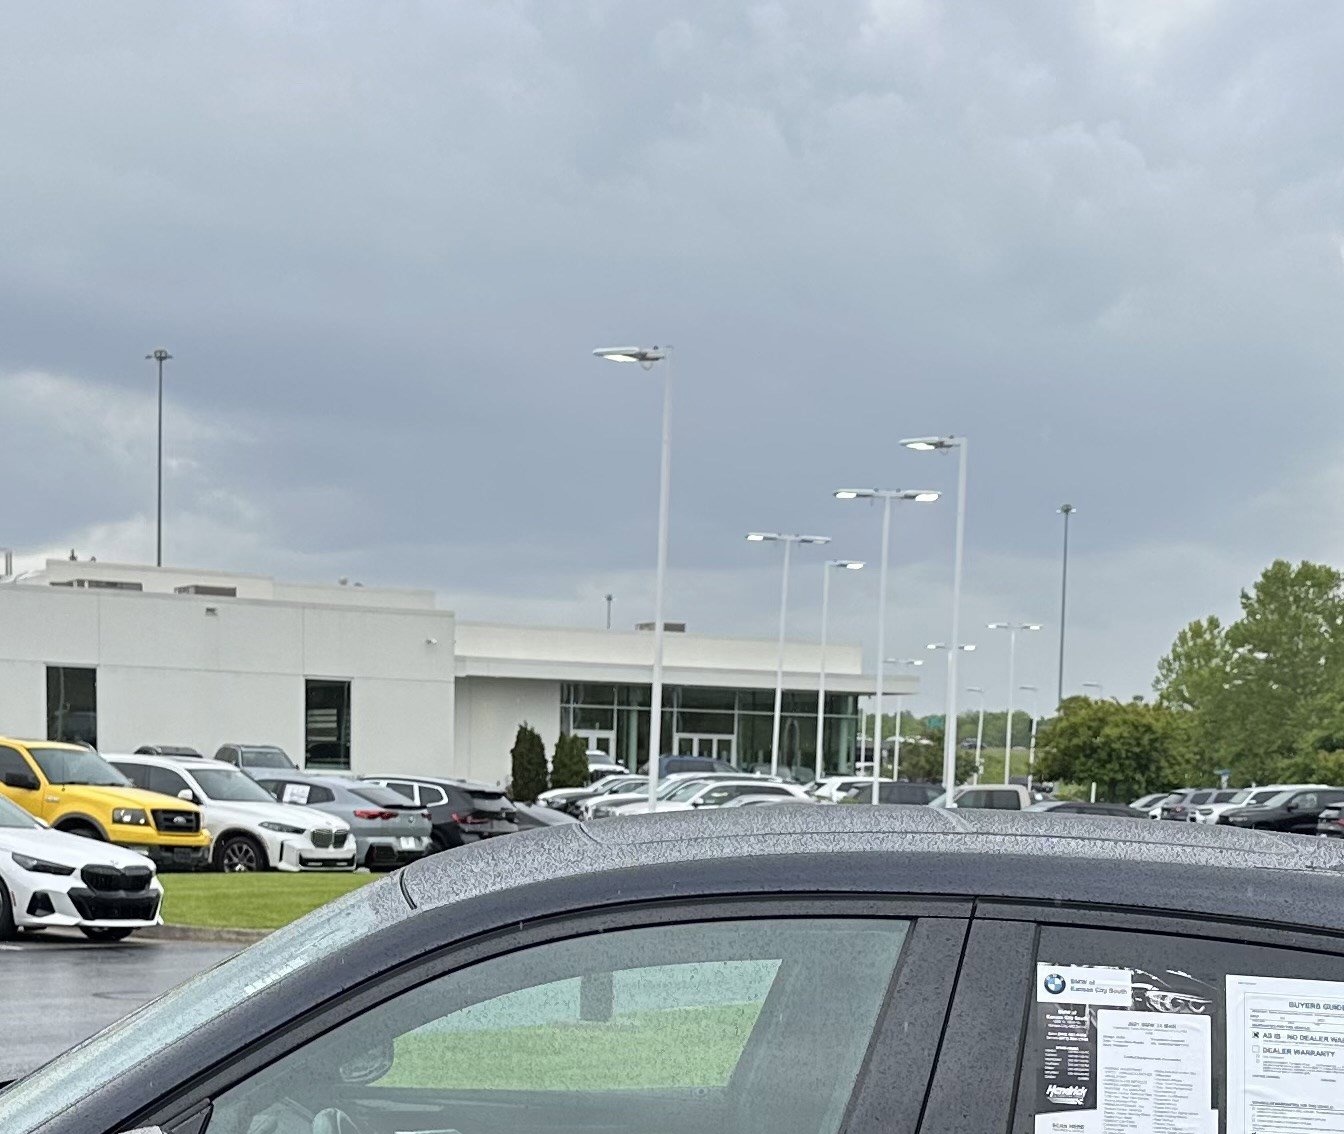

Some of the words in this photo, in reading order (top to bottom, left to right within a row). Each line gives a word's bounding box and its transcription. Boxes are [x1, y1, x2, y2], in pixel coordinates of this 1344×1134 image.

[1288, 1001, 1321, 1010] BUYERS
[1299, 1035, 1329, 1043] DEALER
[1262, 1047, 1292, 1055] DEALER
[1293, 1049, 1336, 1057] WARRANTY
[1045, 1085, 1088, 1099] Hendrick
